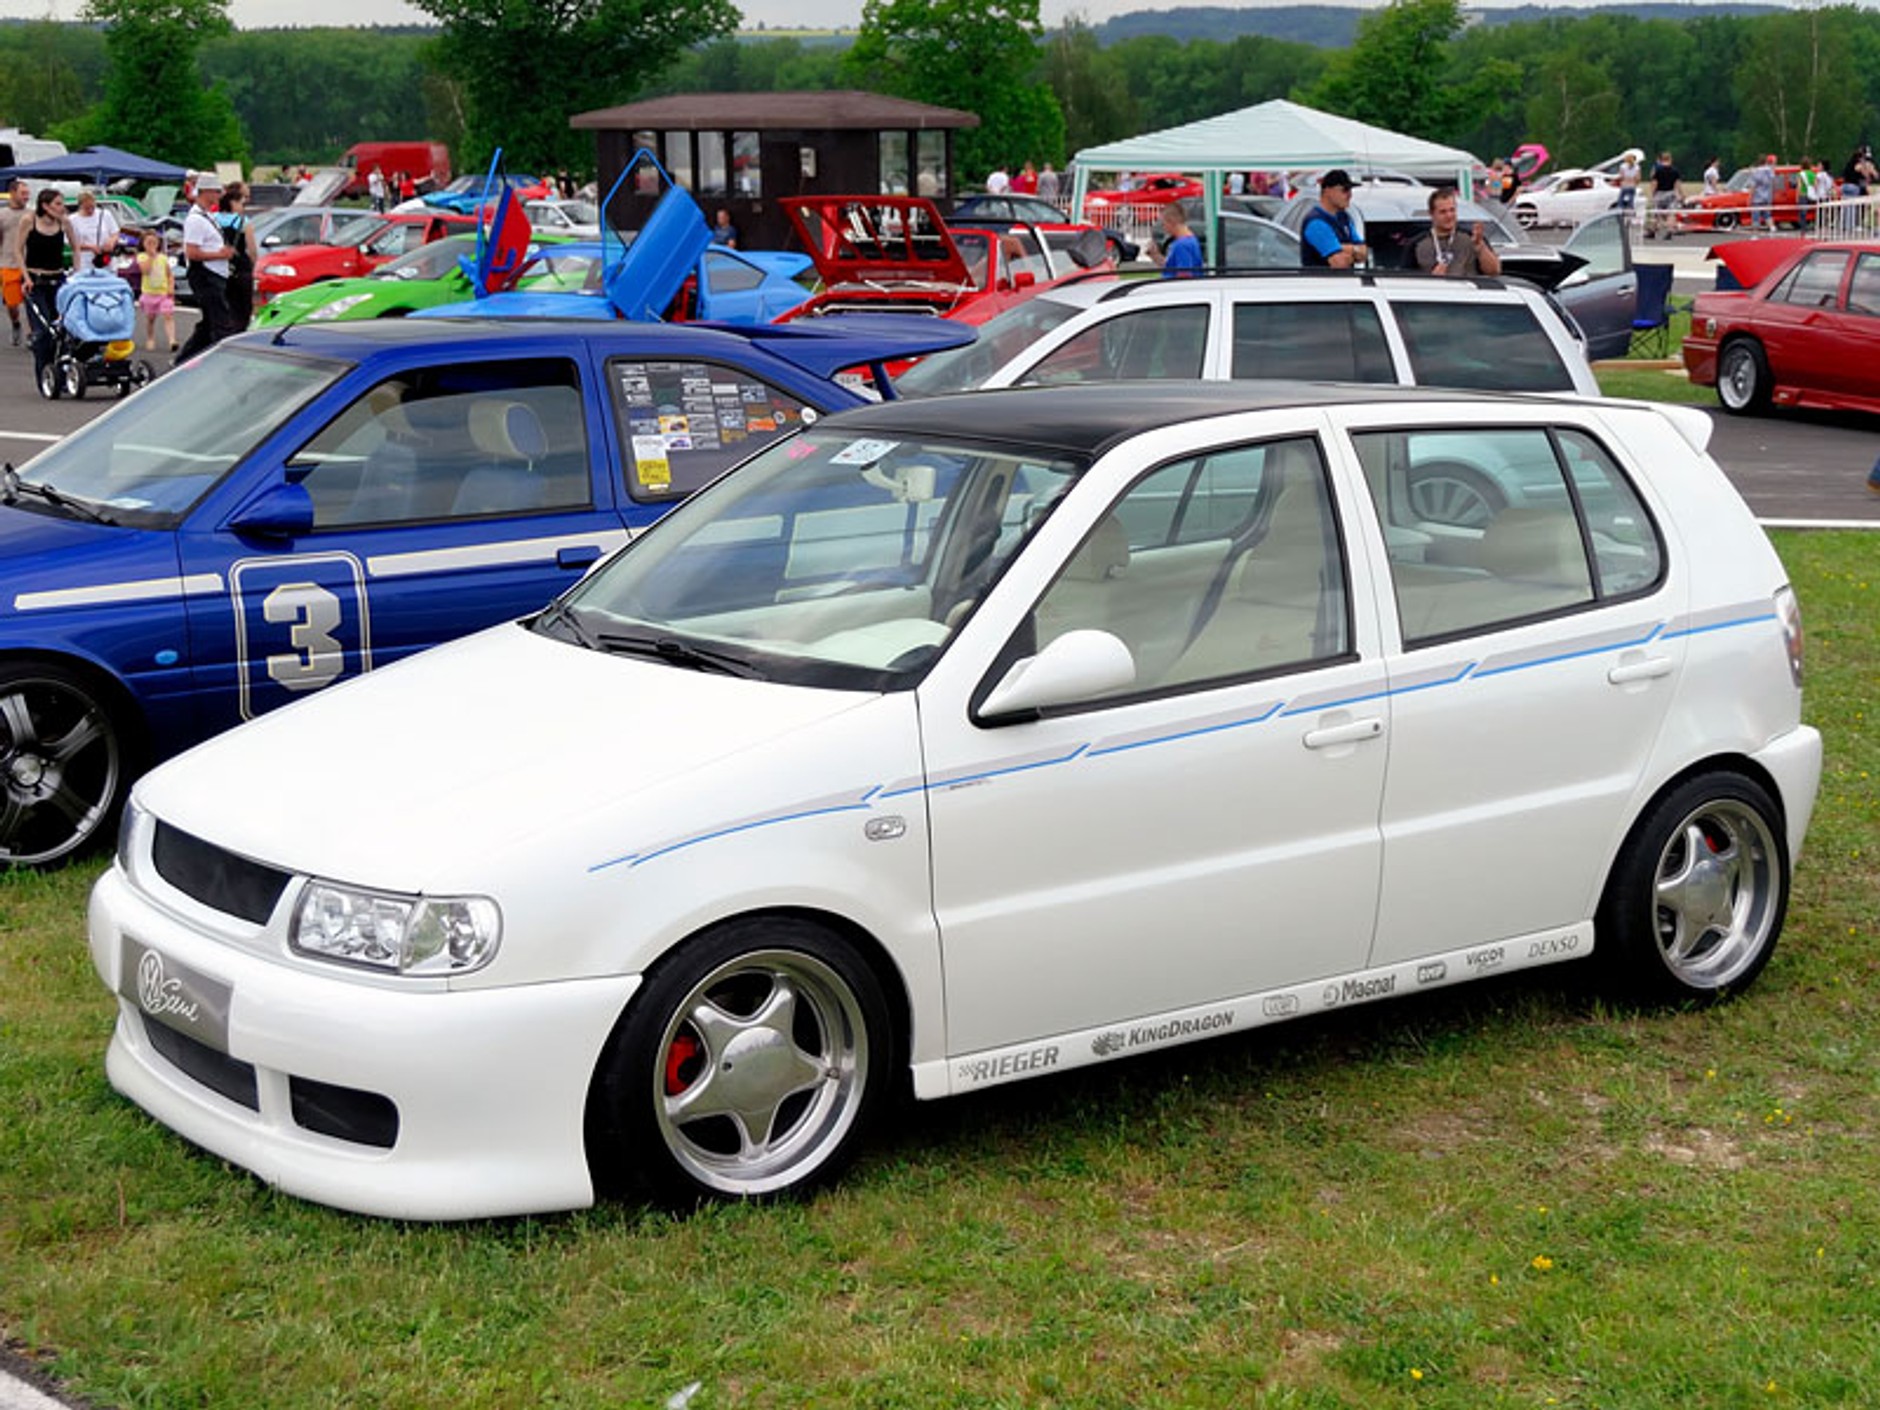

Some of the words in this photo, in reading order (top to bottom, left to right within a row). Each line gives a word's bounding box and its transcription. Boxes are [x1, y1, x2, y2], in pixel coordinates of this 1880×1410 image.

[263, 582, 344, 692] 3
[1528, 935, 1578, 958] DENSO
[973, 1046, 1059, 1080] RIEGER
